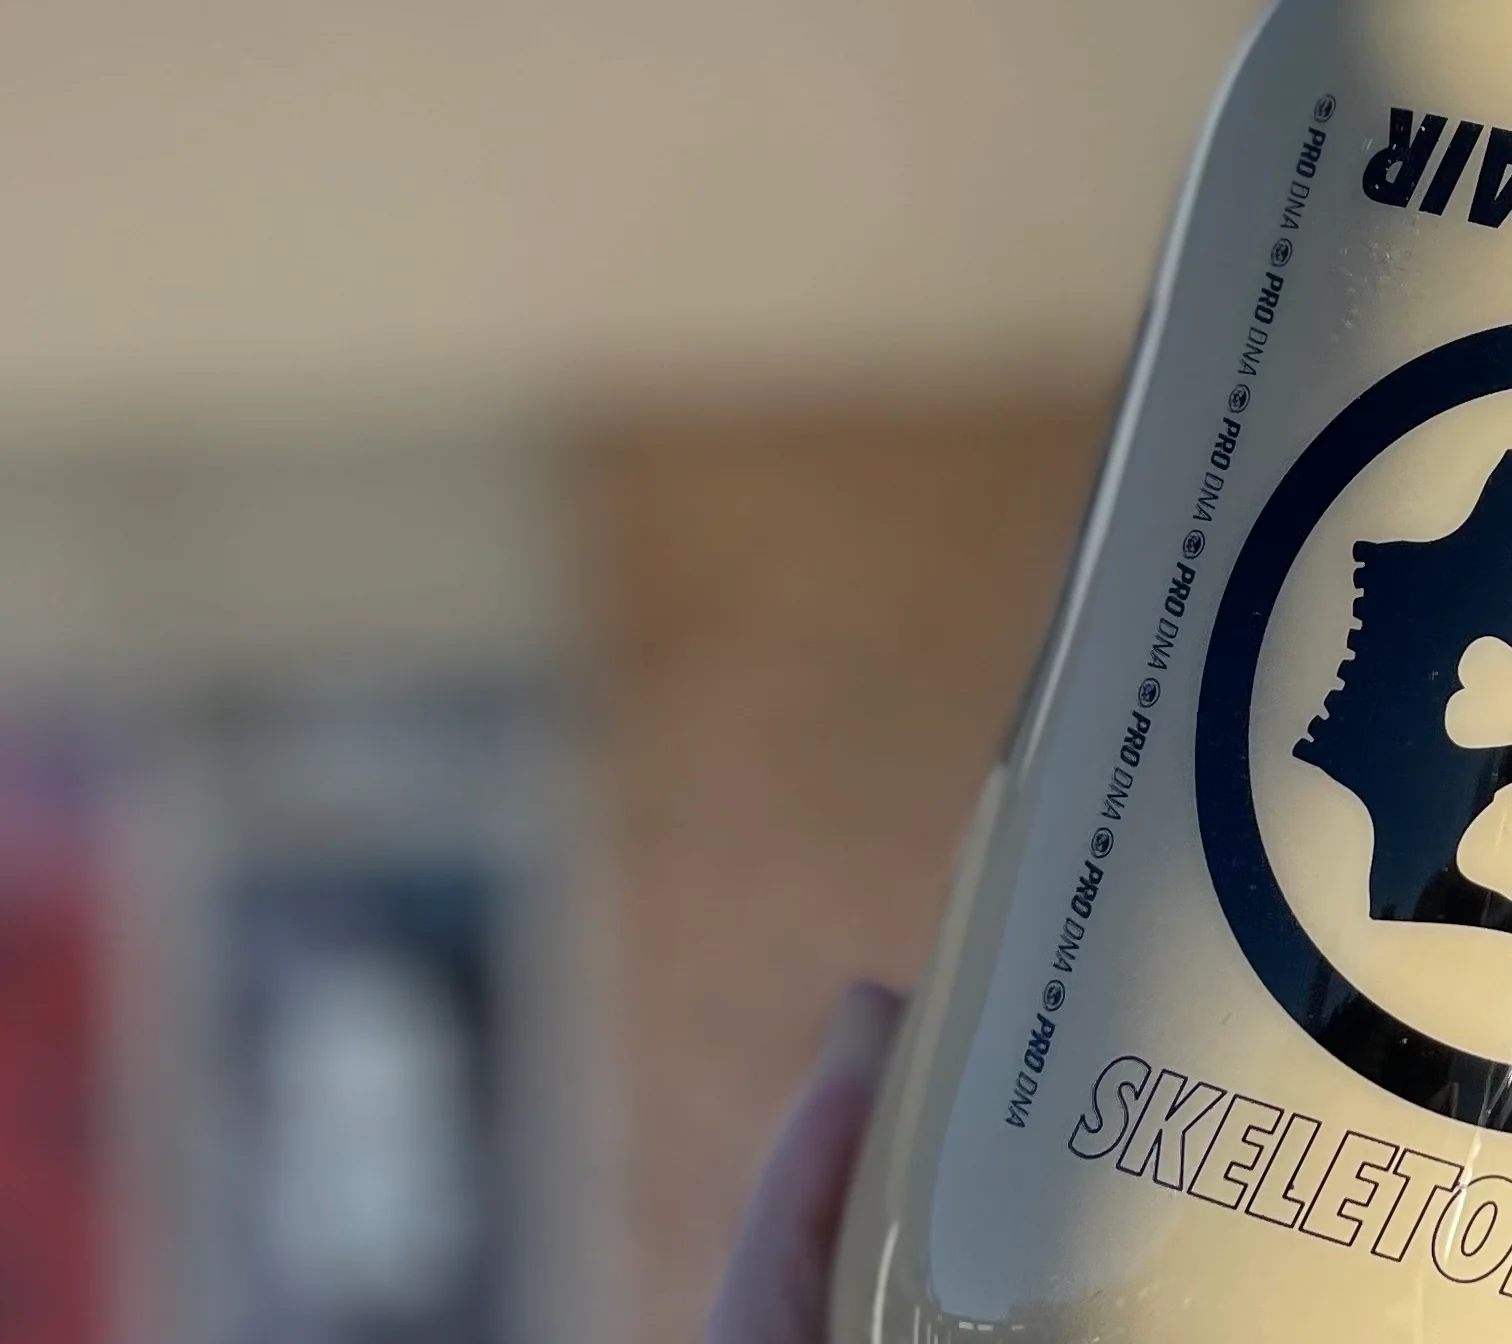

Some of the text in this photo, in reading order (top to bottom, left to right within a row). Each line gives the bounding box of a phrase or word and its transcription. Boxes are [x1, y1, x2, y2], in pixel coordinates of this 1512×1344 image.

[1006, 127, 1327, 1129] PRO DNA PRO DNA PRO DNA PRO DNA PRO DNA PRO DNA PRO DNA
